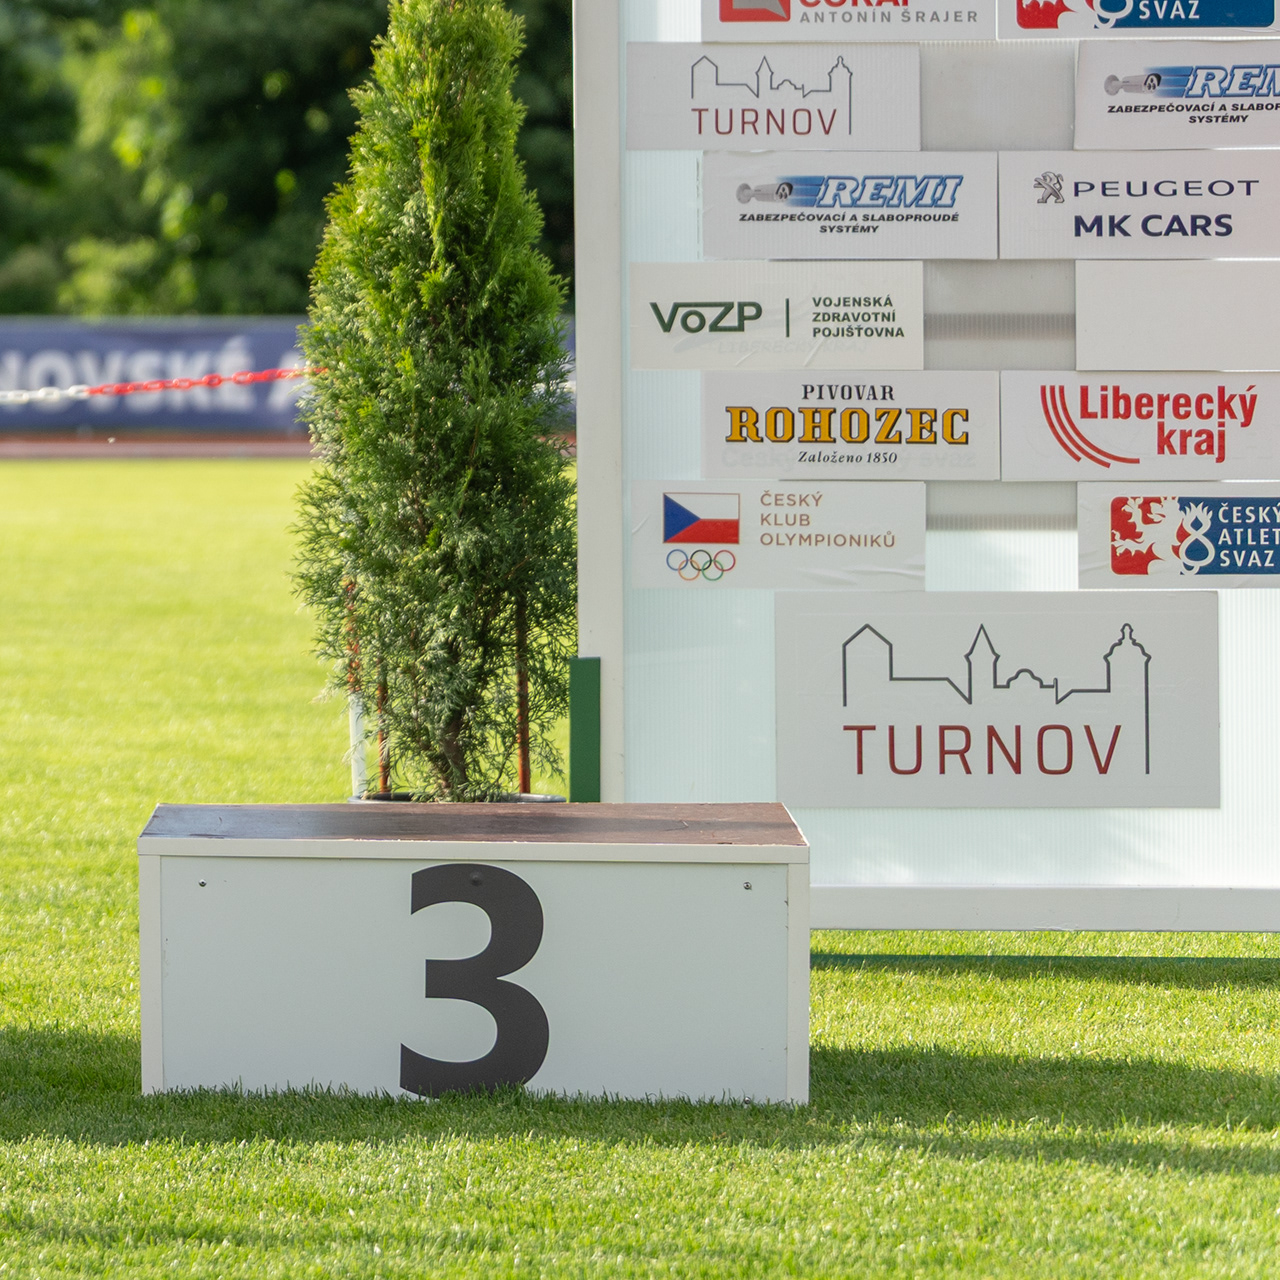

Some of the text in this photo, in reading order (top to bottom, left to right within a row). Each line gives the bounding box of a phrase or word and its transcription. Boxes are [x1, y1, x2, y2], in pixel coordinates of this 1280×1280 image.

[800, 8, 977, 23] ANTONÍN ŠRAJER
[1138, 0, 1200, 20] SVAZ
[1107, 101, 1215, 114] ZABEZPEČOVACÍ
[1218, 103, 1228, 112] A
[692, 108, 838, 135] TURNOV
[1188, 112, 1249, 124] SYSTÉMY
[816, 174, 965, 208] REMI
[1074, 179, 1259, 197] PEUGEOT
[739, 211, 959, 223] ZABEZPEČOVACÍ A SLABOPROUDÉ
[1074, 214, 1233, 237] MK CARS
[819, 222, 880, 233] SYSTÉMY
[812, 295, 892, 308] VOJENSKÁ
[812, 310, 896, 323] ZDRAVOTNÍ
[812, 324, 905, 339] POJIŠŤOVNA
[801, 384, 895, 401] PIVOVAR
[1079, 384, 1258, 427] Liberecký
[725, 407, 969, 446] ROHOZEC
[1156, 421, 1226, 463] kraj
[798, 449, 864, 464] Založeno
[867, 451, 898, 464] 1850
[760, 490, 823, 507] ČESKÝ
[760, 513, 811, 528] KLUB
[760, 530, 896, 548] OLYMPIONIKŮ
[1219, 550, 1275, 567] SVAZ
[843, 723, 1121, 776] TURNOV
[400, 863, 550, 1098] 3
